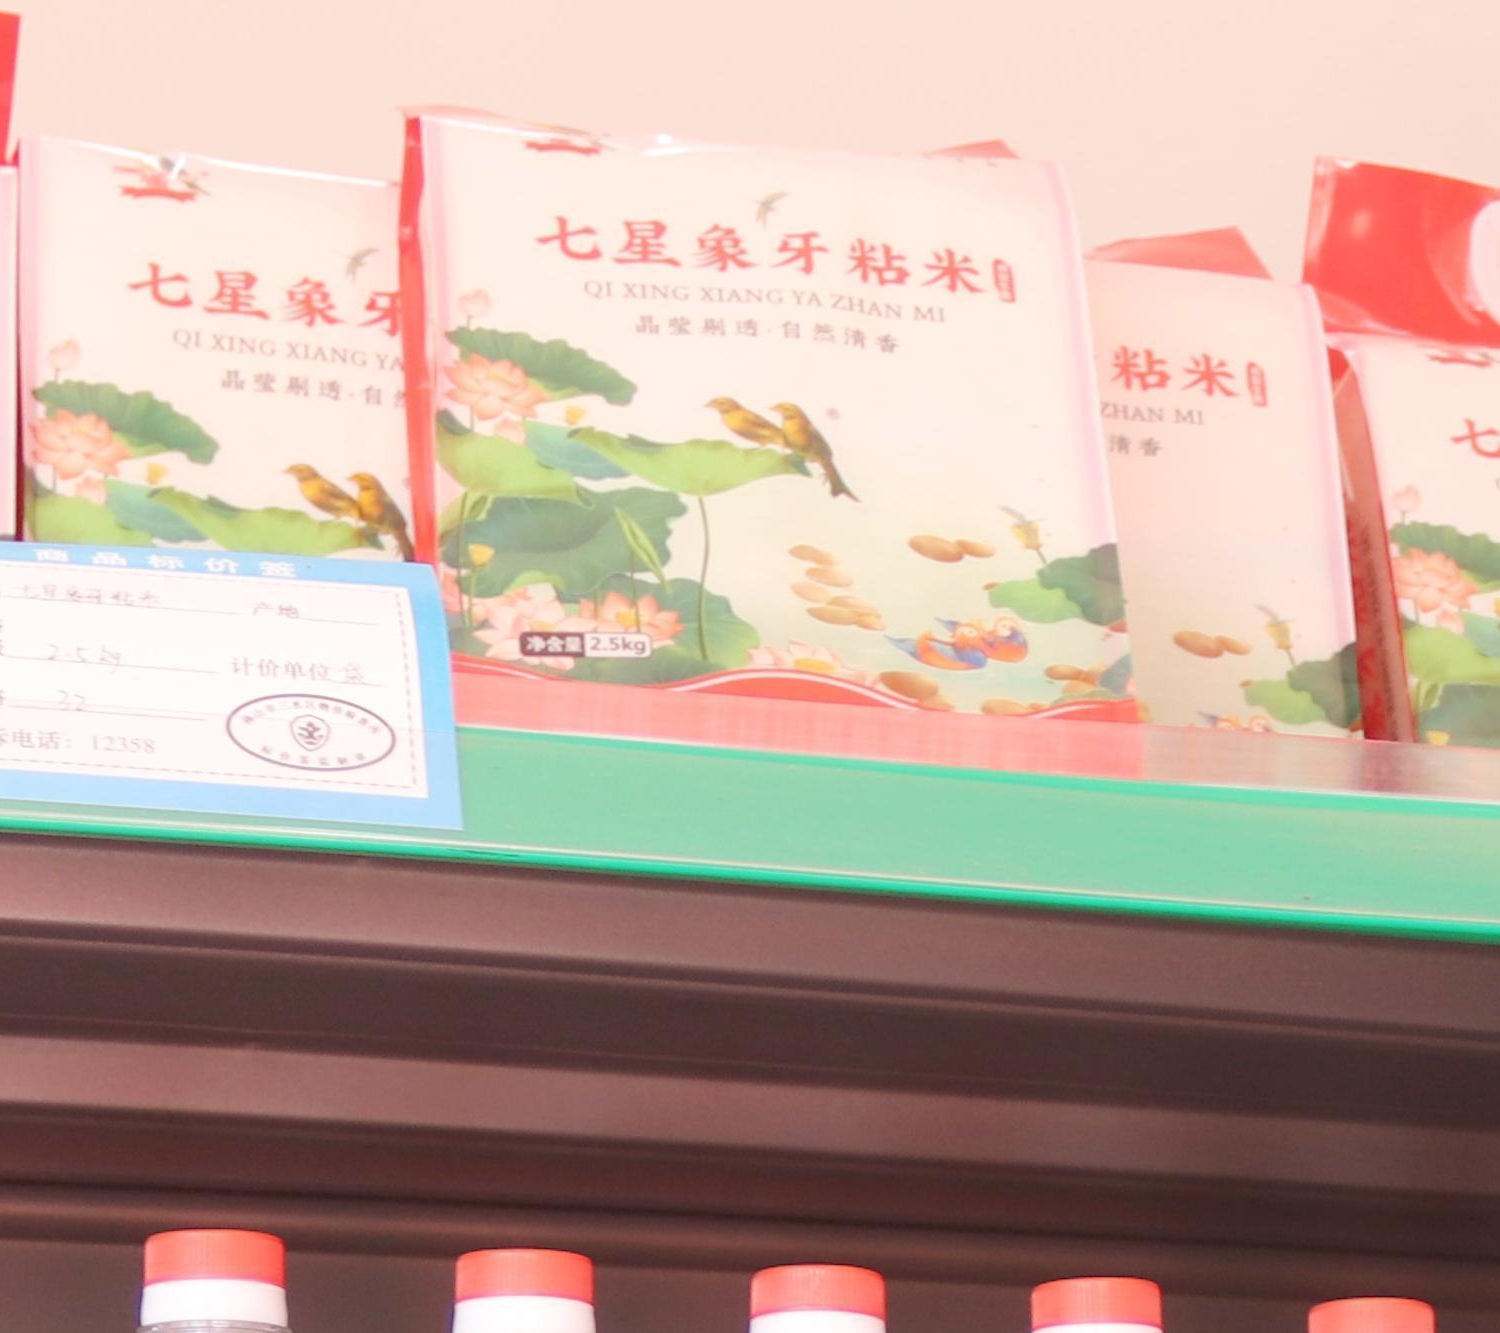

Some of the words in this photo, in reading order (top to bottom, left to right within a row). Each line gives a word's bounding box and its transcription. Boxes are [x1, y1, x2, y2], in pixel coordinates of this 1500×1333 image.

[536, 216, 985, 295] 七星象牙粘米
[127, 262, 400, 337] 七星象牙
[584, 280, 613, 299] QI
[623, 281, 690, 301] XING
[699, 287, 783, 305] XIANG
[791, 290, 823, 308] YA
[830, 294, 902, 319] ZHAN
[913, 306, 945, 323] MI
[173, 329, 200, 348] QI
[213, 333, 275, 356] XING
[287, 341, 367, 367] XIANG
[375, 353, 405, 372] YA
[1110, 345, 1239, 397] 粘米
[1100, 401, 1164, 422] ZHAN
[1174, 409, 1205, 425] MI
[33, 548, 299, 579] 商品标价签
[526, 635, 582, 653] 净含量
[590, 637, 647, 654] 2.5kg
[230, 656, 332, 682] 计价单位
[91, 733, 156, 755] 12358
